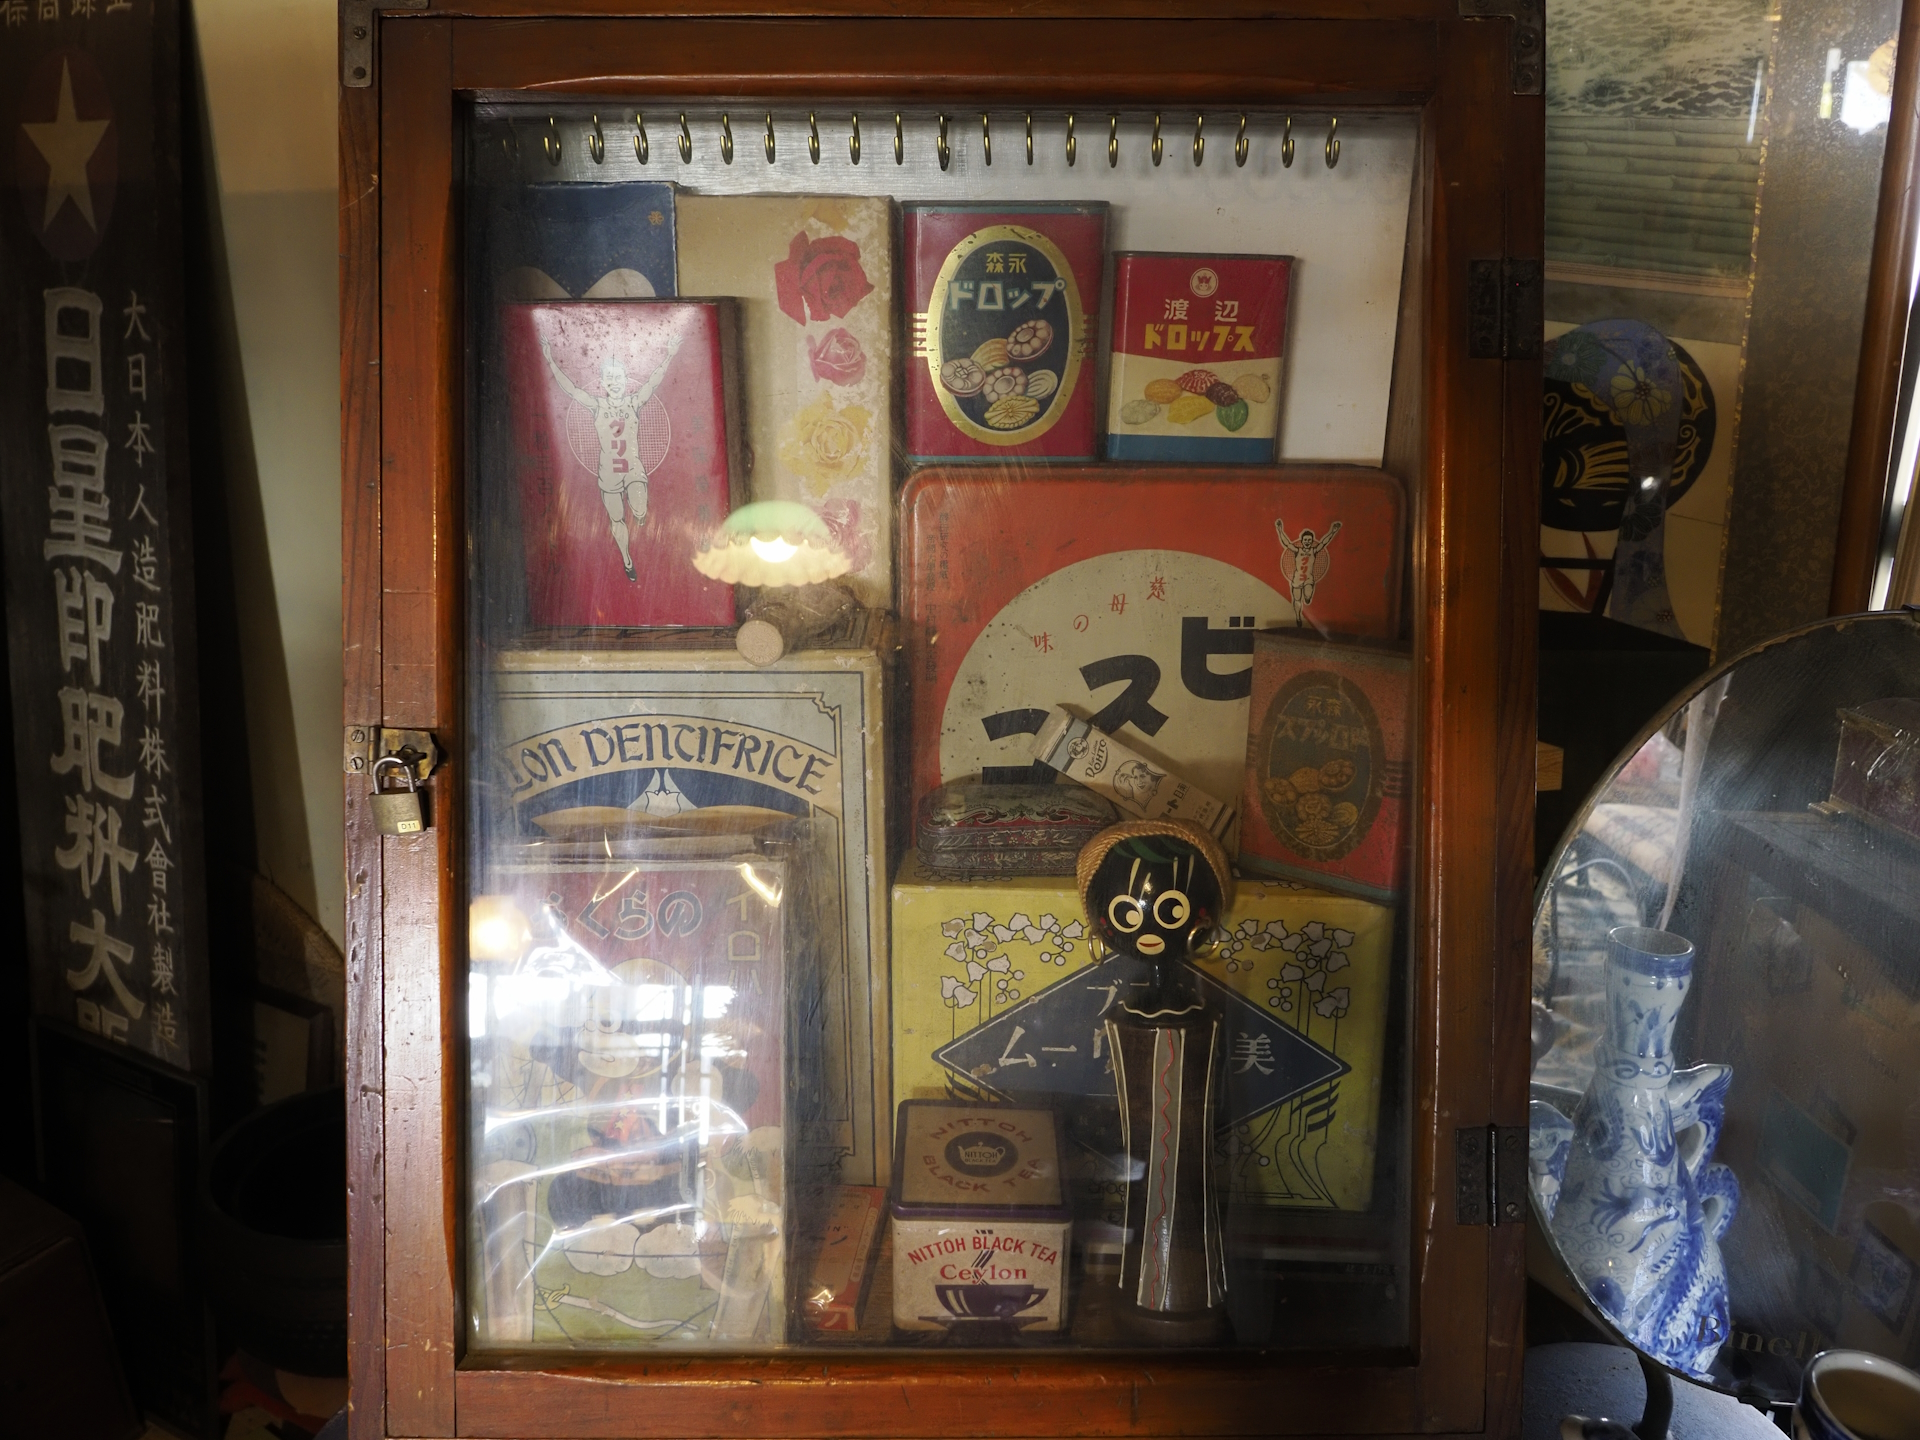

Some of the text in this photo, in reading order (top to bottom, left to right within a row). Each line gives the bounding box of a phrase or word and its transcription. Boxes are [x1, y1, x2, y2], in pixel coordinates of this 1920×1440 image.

[986, 252, 1027, 274] 森永
[948, 278, 1068, 311] ドロップ
[1144, 323, 1256, 353] ドロップス
[603, 411, 630, 420] GLYCO
[608, 418, 630, 474] グリコ
[1299, 556, 1310, 581] グリコ
[579, 722, 834, 796] DENTIFRICE
[1085, 738, 1108, 778] ROHTO
[929, 1117, 1034, 1144] NITTOH
[964, 1151, 998, 1159] NITTOH
[922, 1154, 1042, 1193] BLACK TEA
[907, 1236, 1058, 1266] NITTOH BLACK TEA
[940, 1264, 1027, 1284] Ceylon
